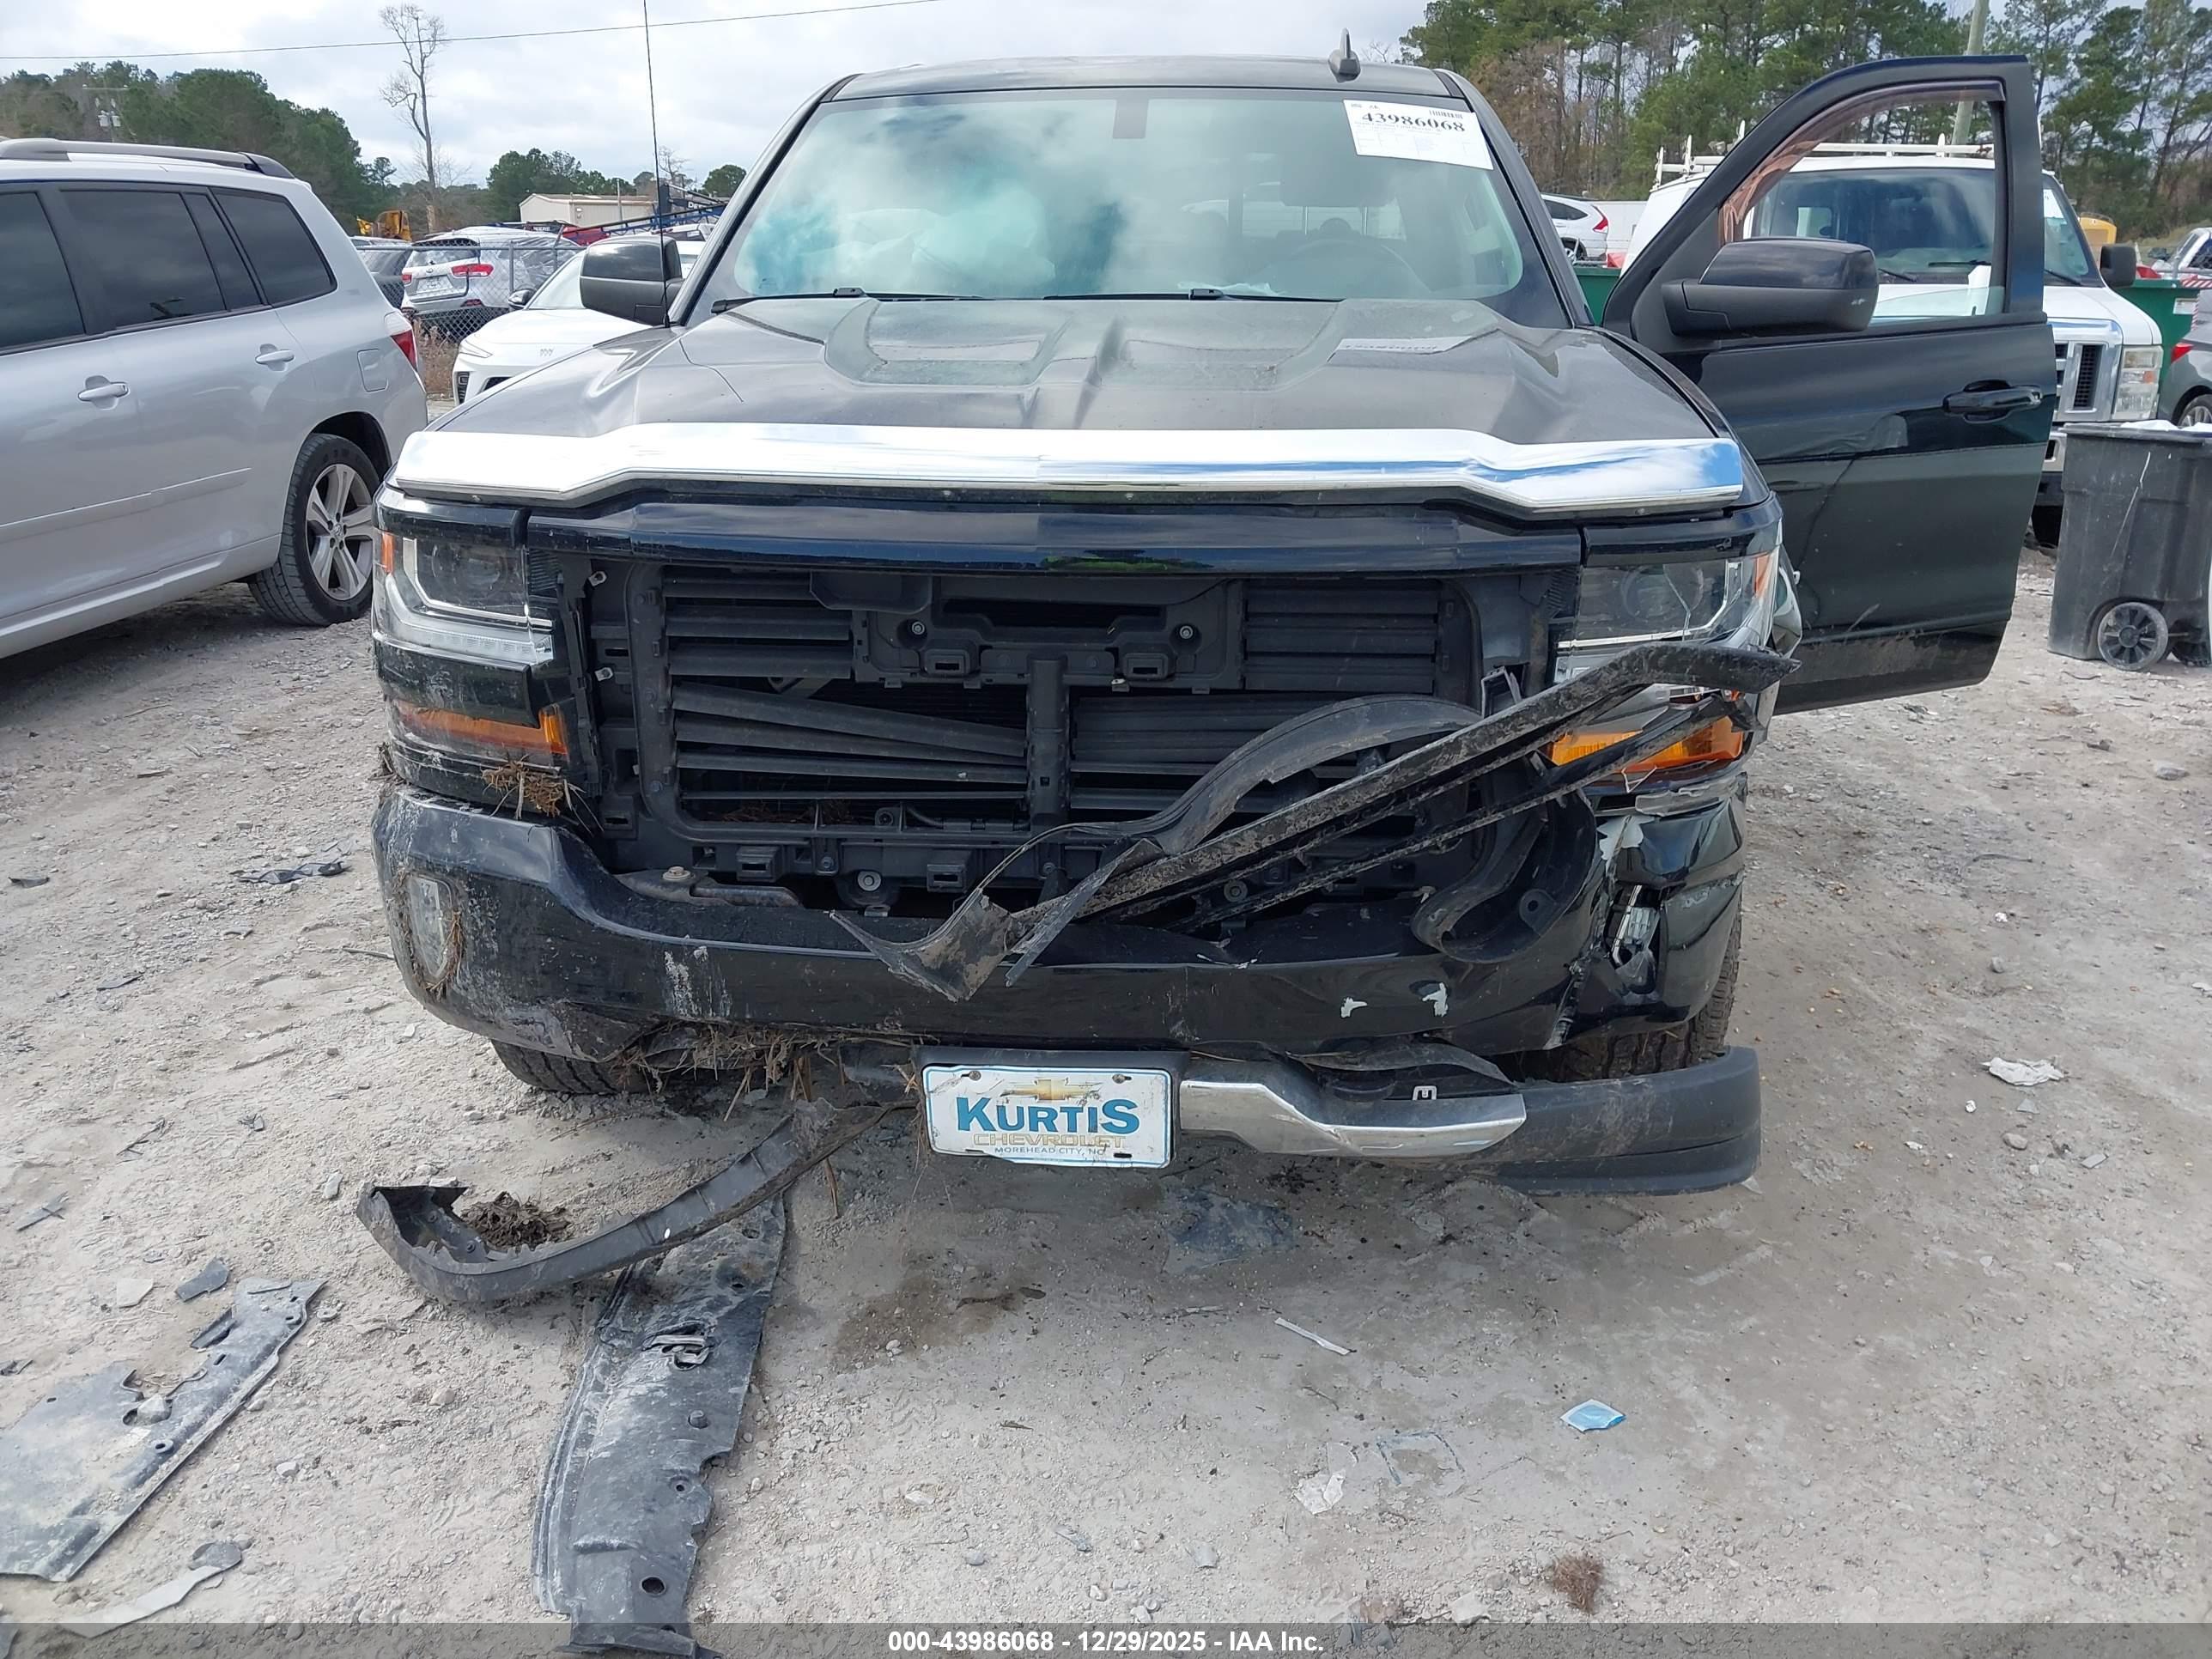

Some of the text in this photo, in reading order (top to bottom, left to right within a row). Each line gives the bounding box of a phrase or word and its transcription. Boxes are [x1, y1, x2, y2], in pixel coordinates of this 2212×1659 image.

[1361, 112, 1466, 132] 43986068
[956, 1097, 1140, 1134] KURTIS
[973, 1133, 1127, 1149] CHEVROLET
[1059, 1146, 1085, 1156] CITY,
